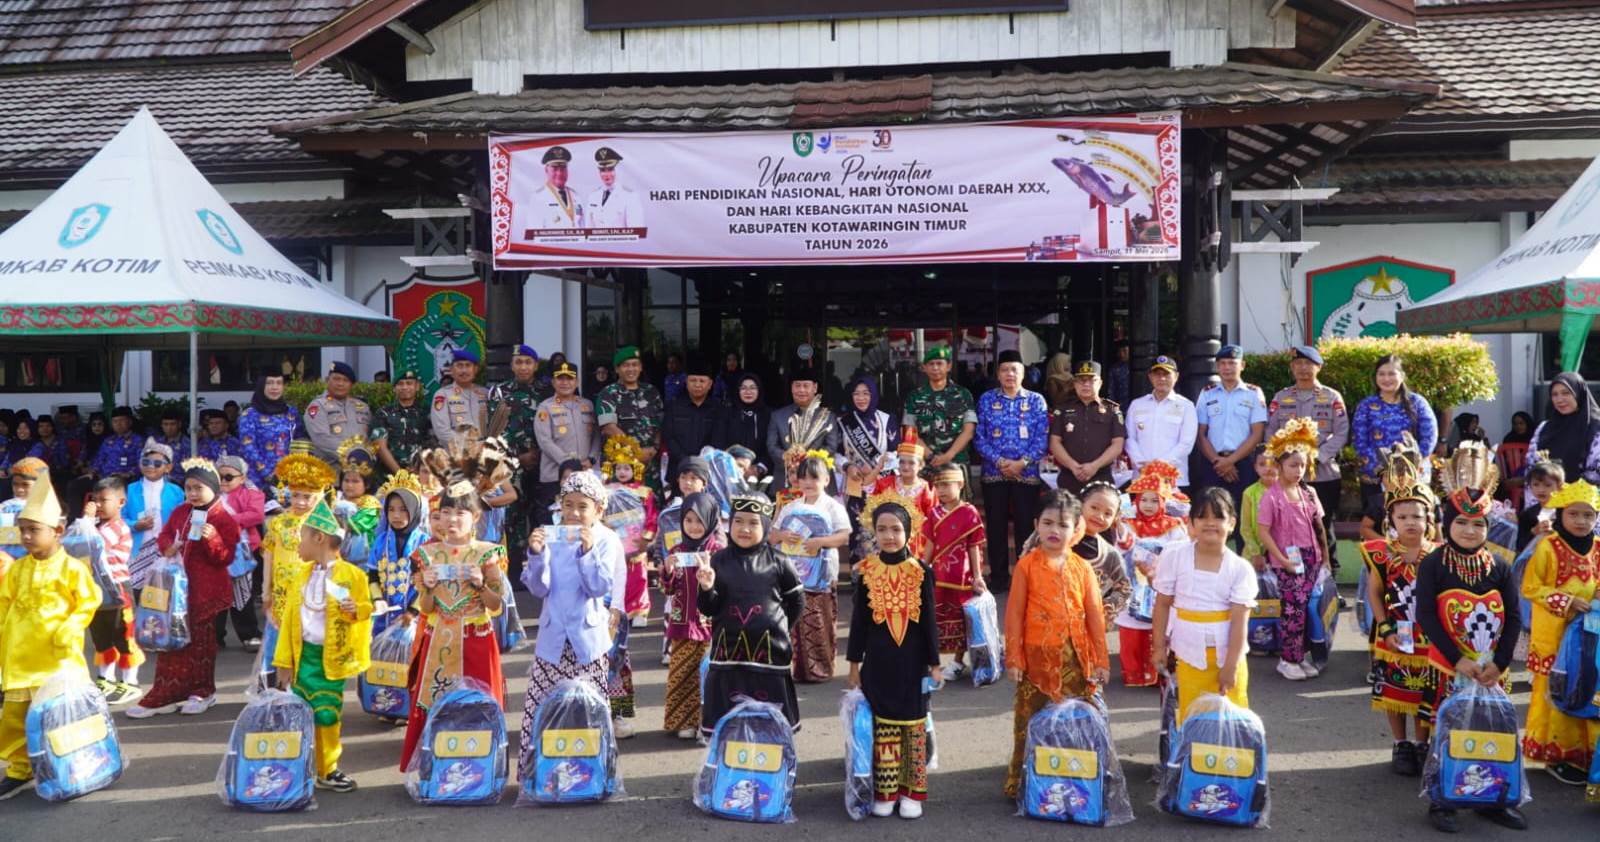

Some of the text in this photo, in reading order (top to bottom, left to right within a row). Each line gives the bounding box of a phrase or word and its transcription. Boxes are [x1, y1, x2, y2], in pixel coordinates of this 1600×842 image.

[873, 129, 892, 149] 30
[758, 154, 933, 189] Upacara Peringatan
[650, 182, 1050, 201] HARI PENDIDIKAN NASIONAL, HARI OTONOMI DAERAH XXX,
[727, 202, 968, 217] DAN HARI KEBANGKITAN NASIONAL
[729, 219, 967, 234] KABUPATEN KOTAWARINGIN TIMUR
[805, 238, 888, 250] TAHUN 2026
[0, 258, 162, 275] MKAB KOTIM
[182, 258, 267, 281] PEMKAB
[852, 426, 874, 455] BUNDA
